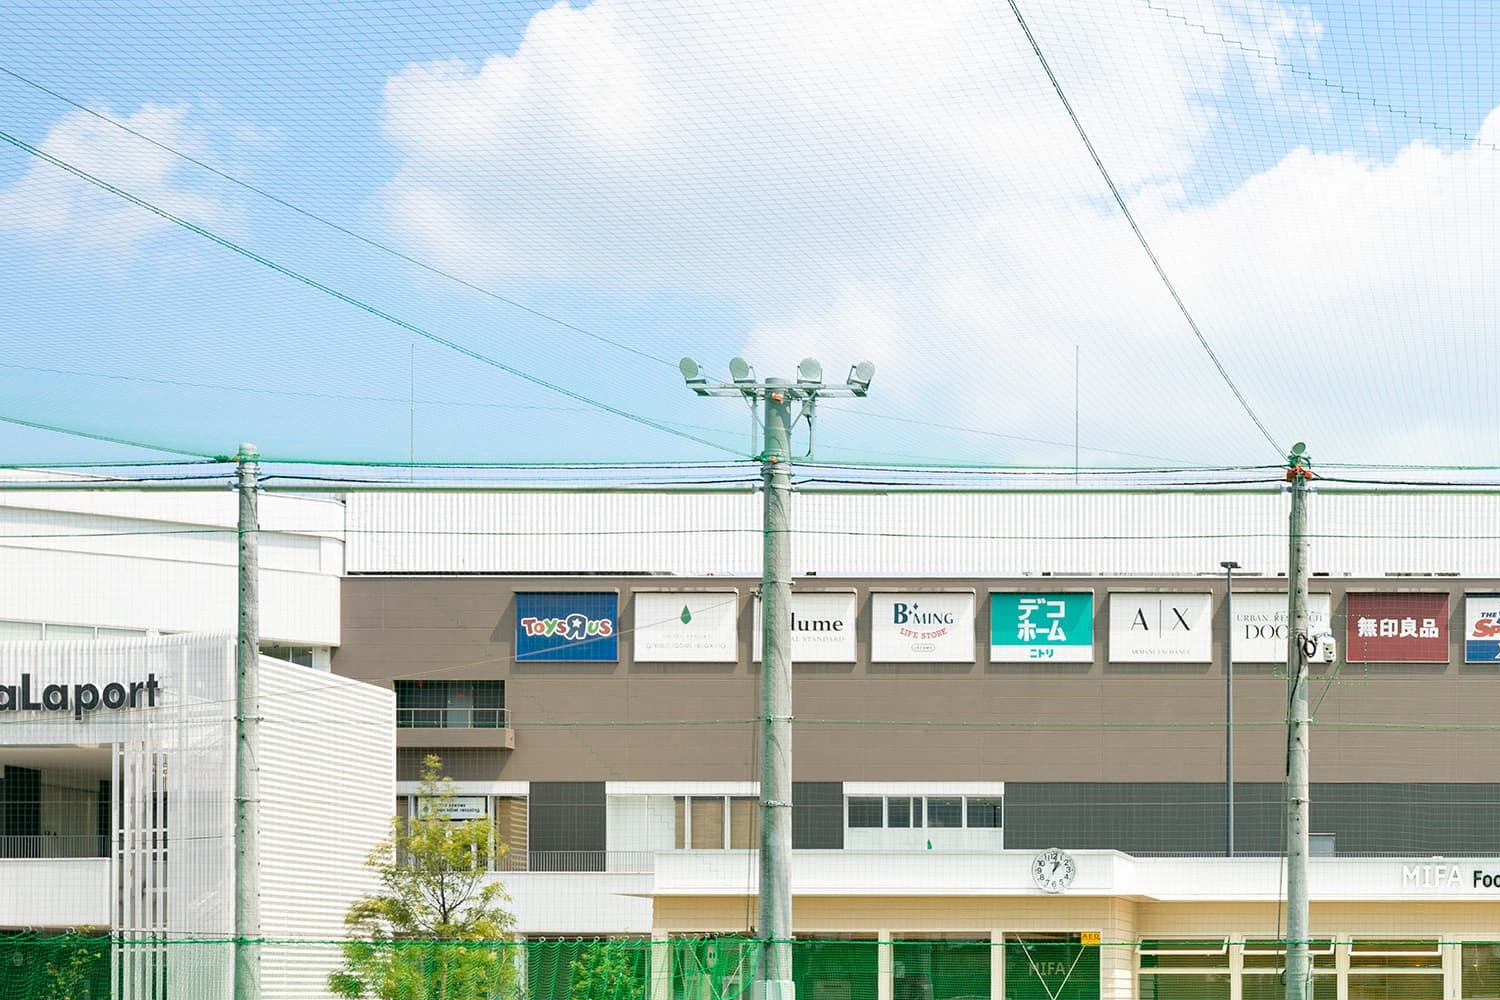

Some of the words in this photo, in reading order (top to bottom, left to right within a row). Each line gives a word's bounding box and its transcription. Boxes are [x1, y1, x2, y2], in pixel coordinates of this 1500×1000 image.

[1018, 598, 1065, 620] デコ
[1236, 614, 1268, 622] URBAN
[791, 612, 843, 631] lume
[1017, 620, 1067, 641] ホーム
[1245, 624, 1288, 639] DOO
[1357, 617, 1439, 638] 無印良品
[900, 628, 919, 639] LIFE
[921, 627, 947, 640] STORE
[1030, 649, 1054, 658] ニトリ
[0, 673, 159, 721] aLaport
[1403, 865, 1463, 888] MIFA
